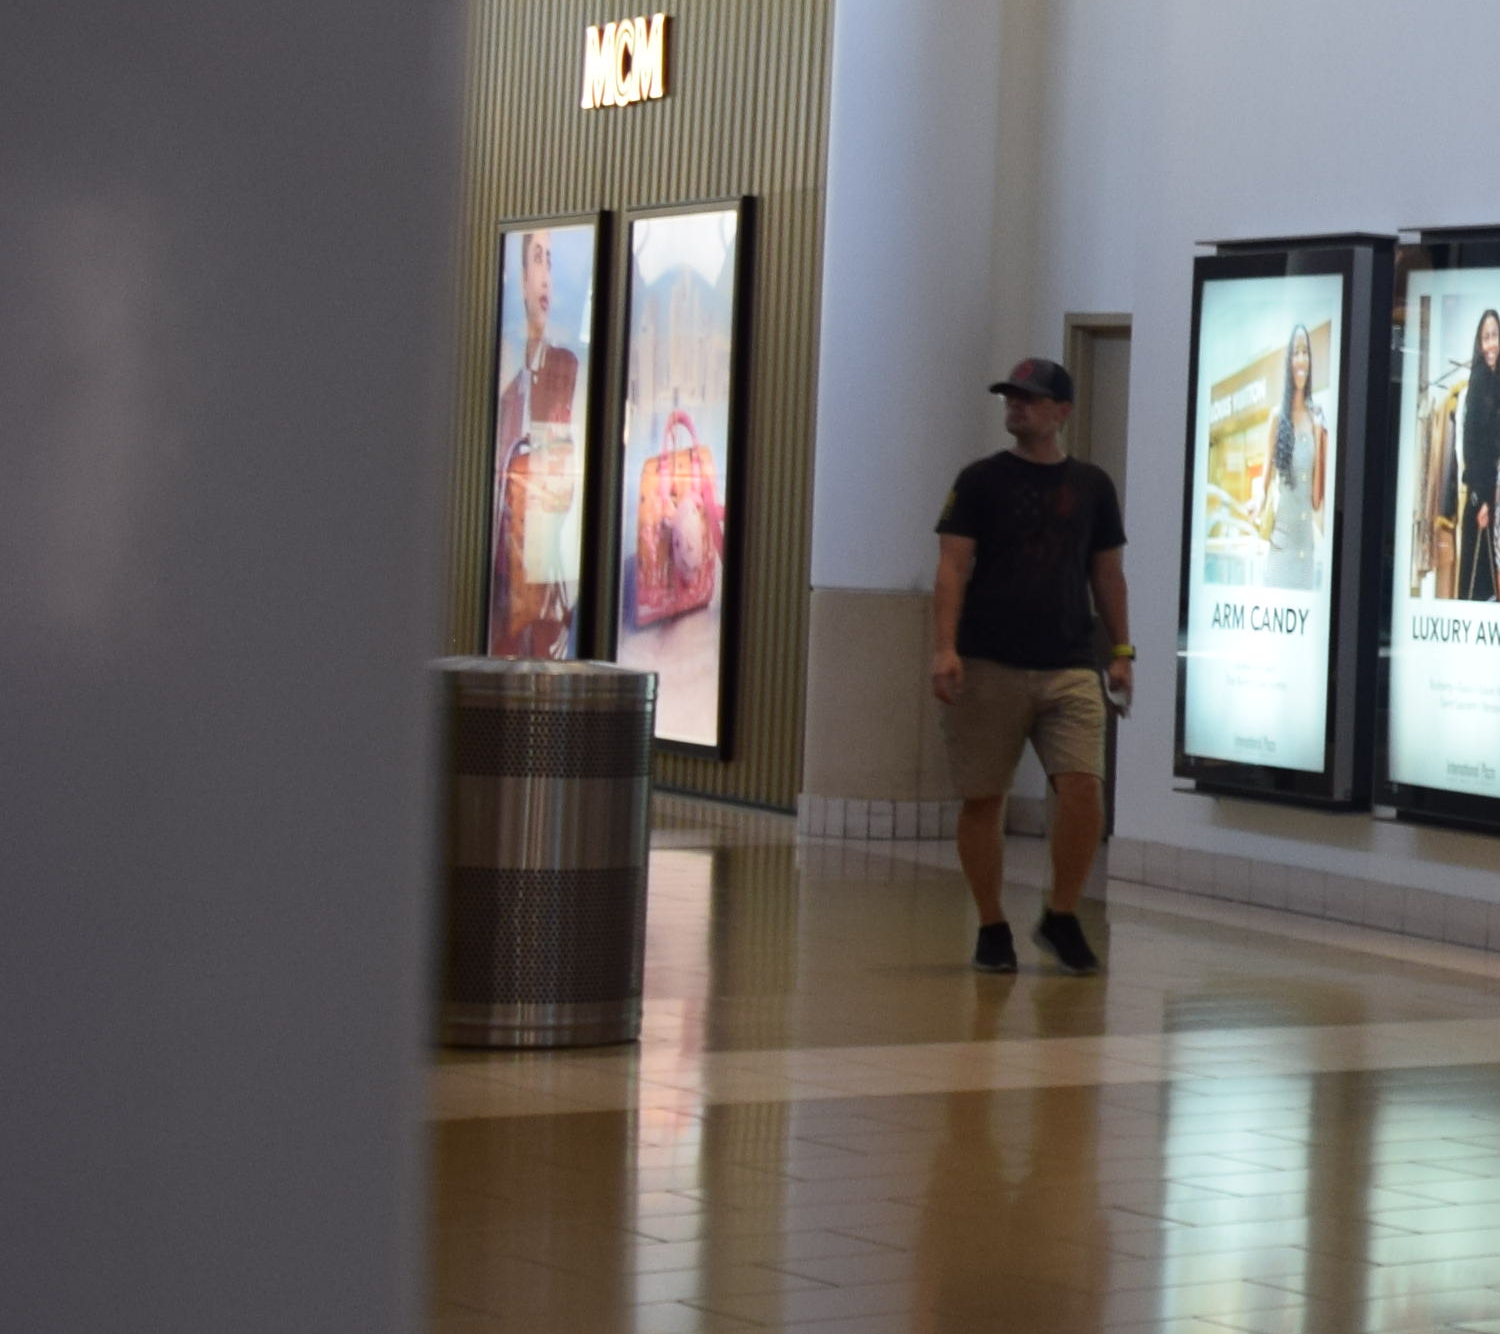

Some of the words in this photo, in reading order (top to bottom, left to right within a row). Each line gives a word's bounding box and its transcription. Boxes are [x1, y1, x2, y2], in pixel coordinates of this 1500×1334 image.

[581, 11, 669, 109] MCM
[1211, 601, 1246, 632] ARM
[1249, 606, 1310, 637] CANDY
[1411, 614, 1472, 645] LUXURY
